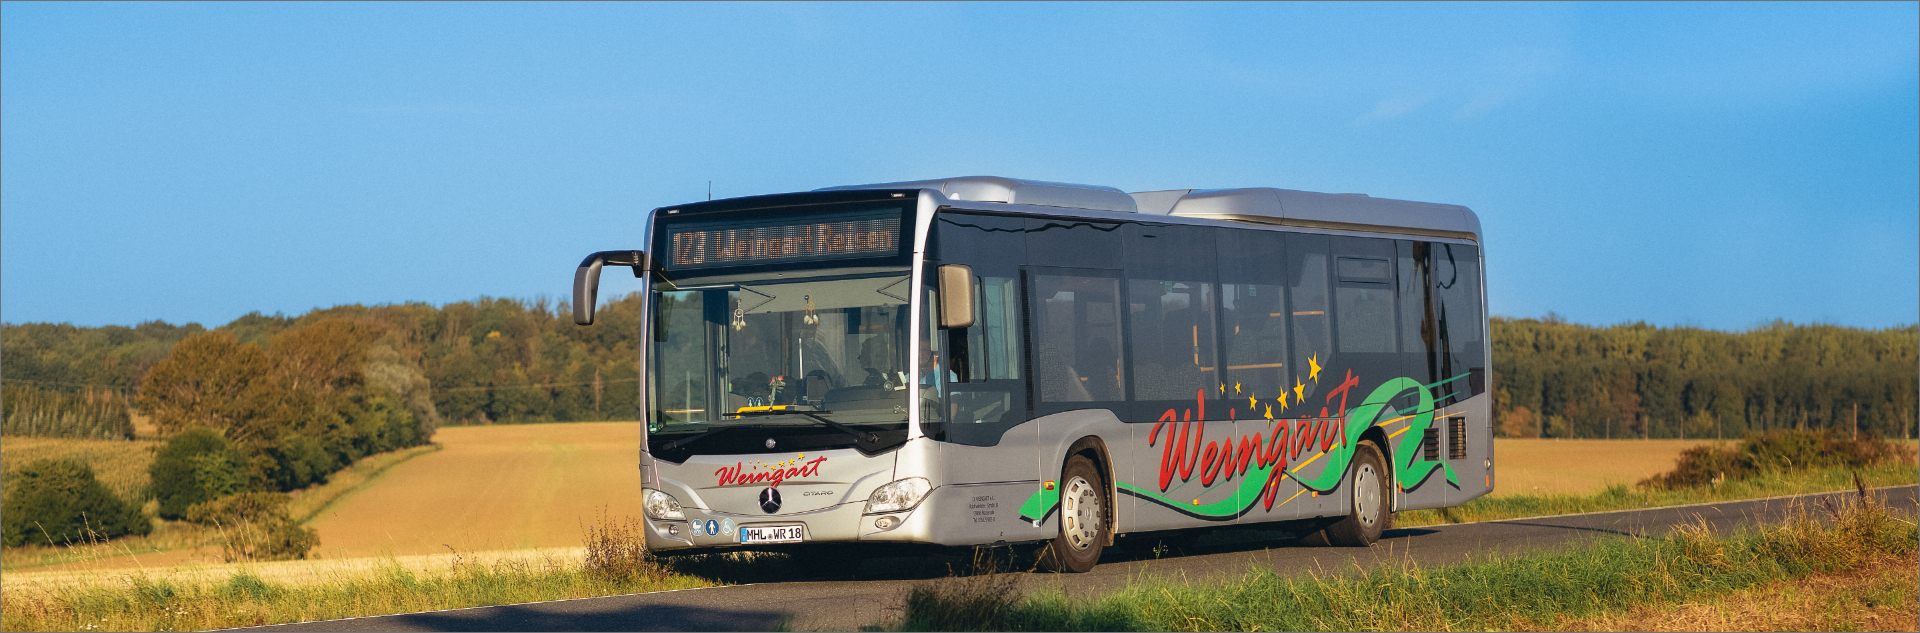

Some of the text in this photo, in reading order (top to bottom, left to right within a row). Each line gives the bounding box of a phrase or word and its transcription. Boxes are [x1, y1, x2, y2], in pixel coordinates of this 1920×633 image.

[673, 223, 893, 265] 123 Weingart Reisen
[1148, 368, 1360, 513] Weingart
[714, 455, 828, 489] Weingart
[747, 527, 802, 540] MHL WR 18
